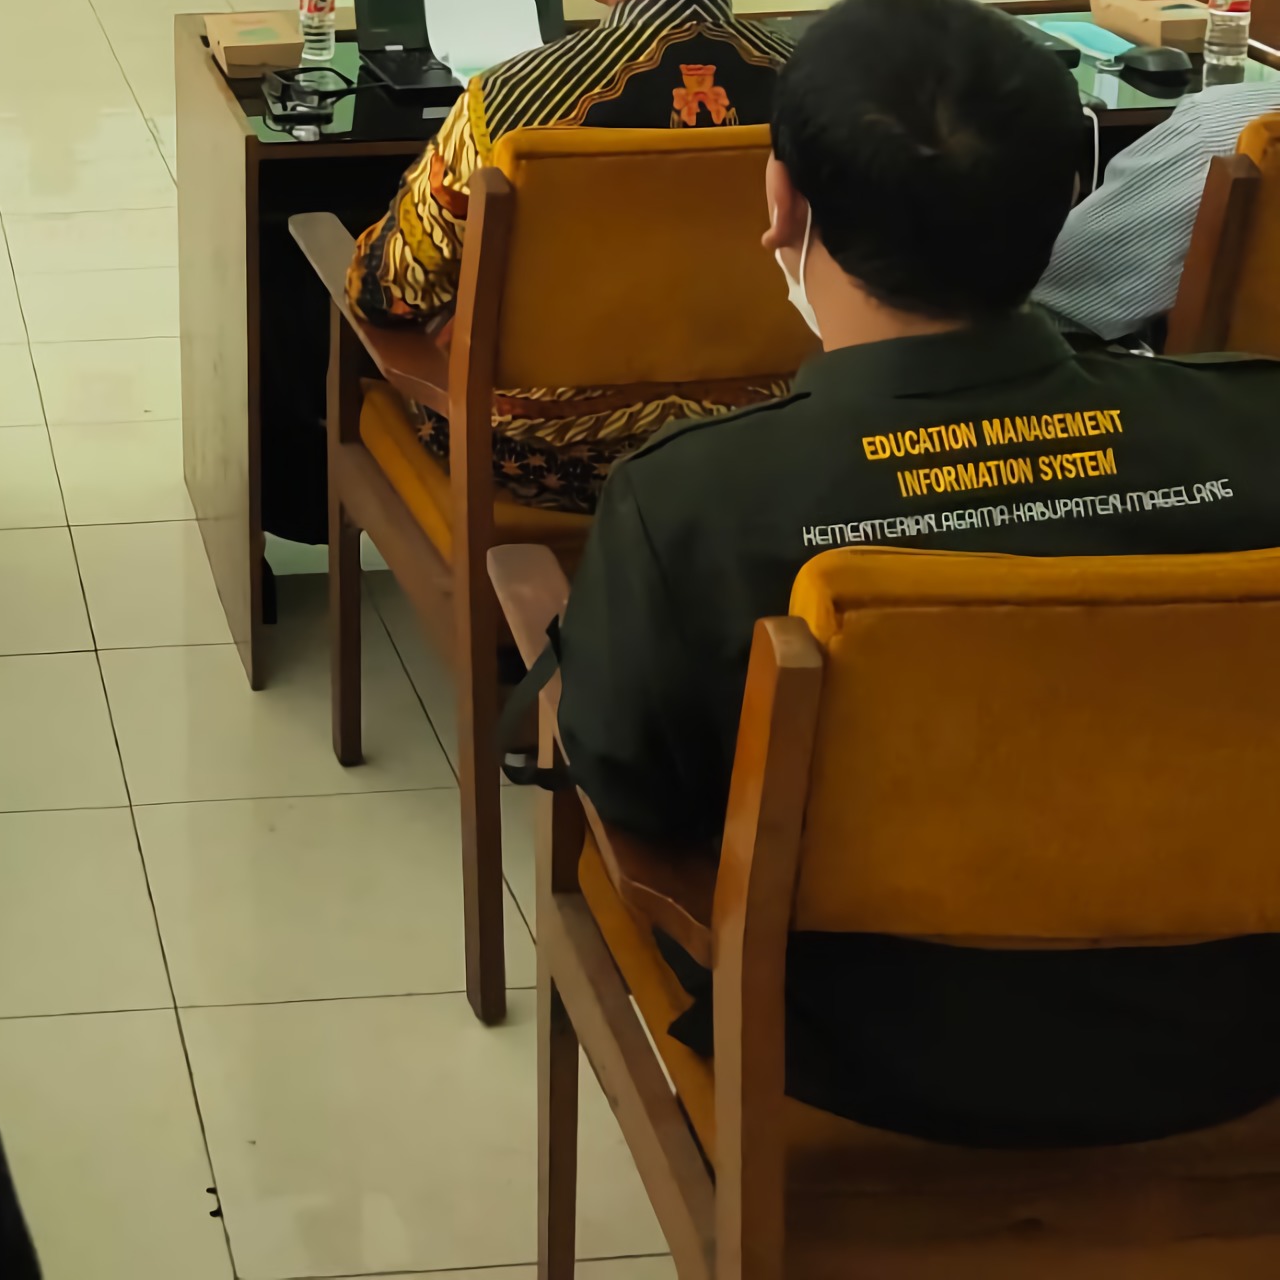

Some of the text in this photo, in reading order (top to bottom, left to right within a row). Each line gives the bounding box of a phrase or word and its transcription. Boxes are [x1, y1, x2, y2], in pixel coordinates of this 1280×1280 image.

[862, 410, 1123, 460] EDUCATION MANAGEMENT
[897, 448, 1117, 497] INFORMATION SYSTEM
[941, 505, 1010, 533] AGAMA
